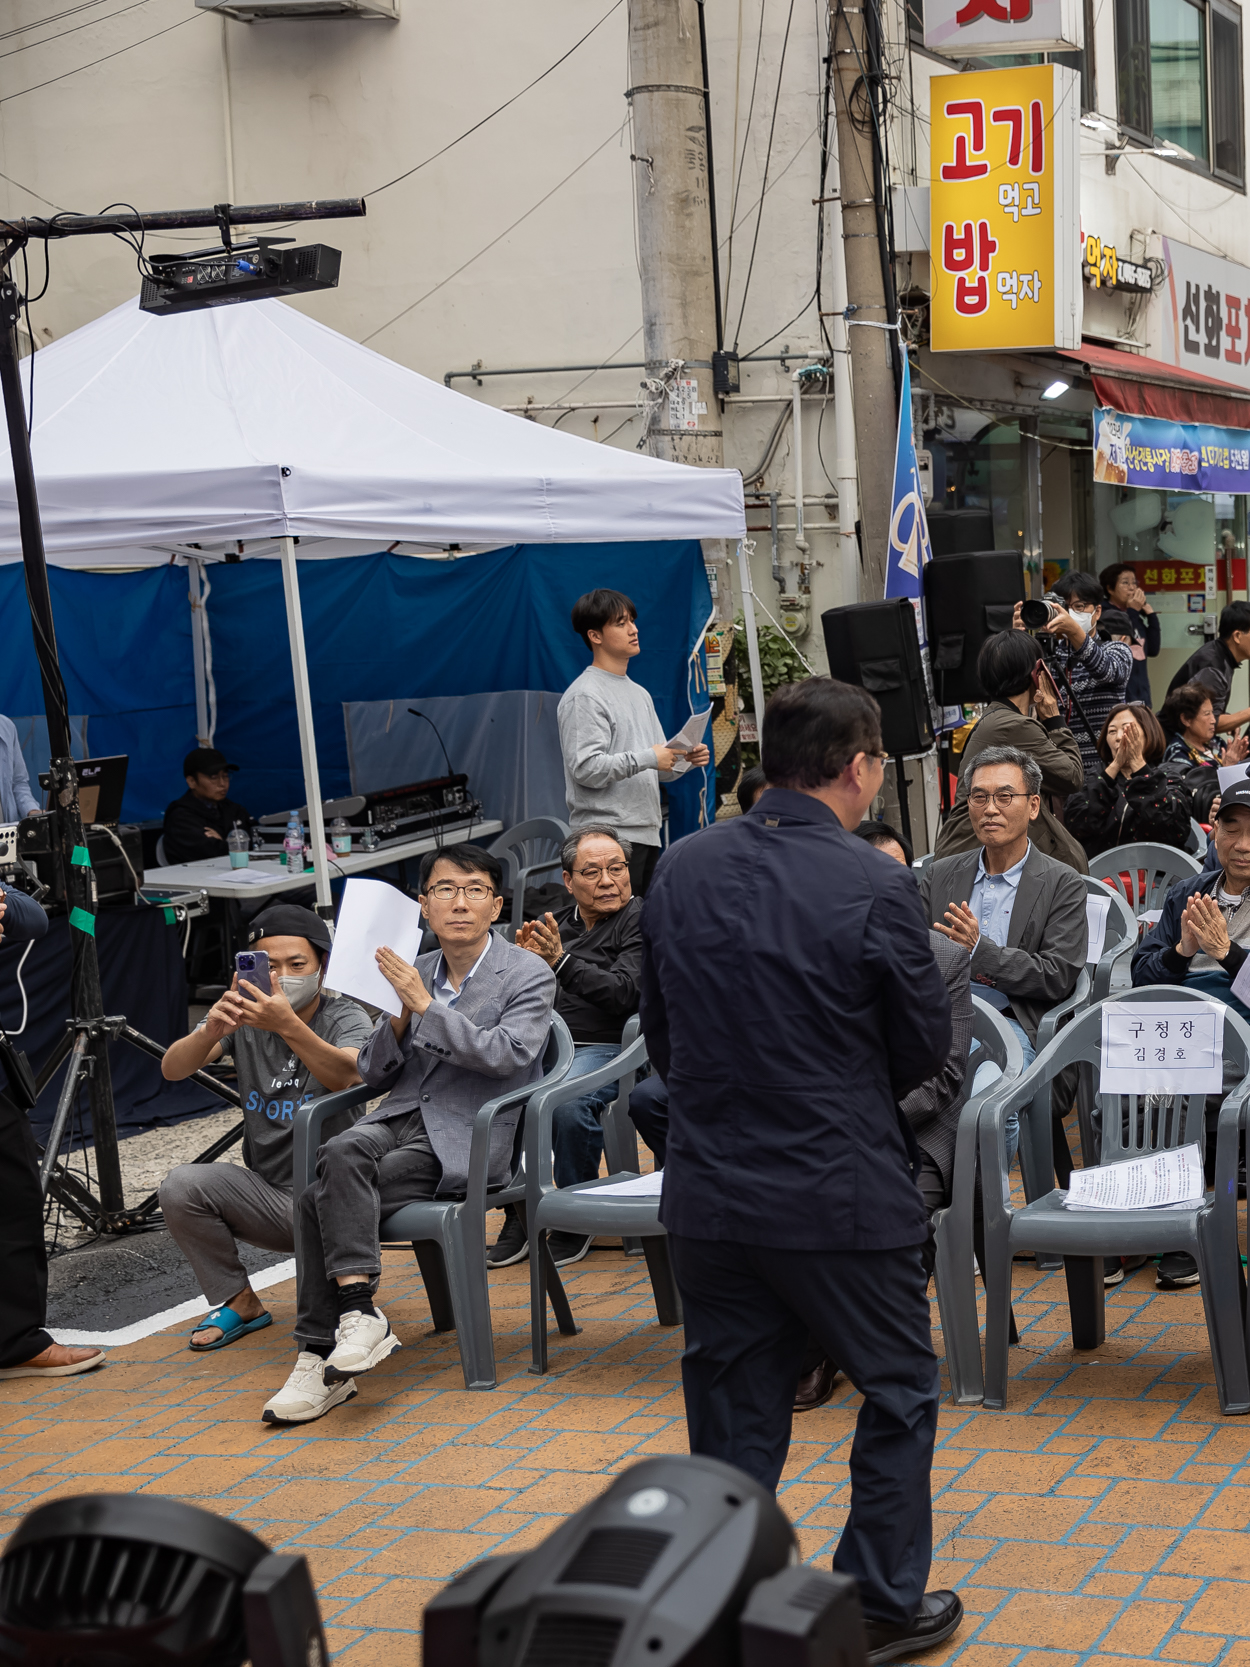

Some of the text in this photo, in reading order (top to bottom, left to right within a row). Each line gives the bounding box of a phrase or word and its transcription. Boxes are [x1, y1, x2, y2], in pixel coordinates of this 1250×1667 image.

[940, 98, 1045, 182] 고기
[998, 182, 1042, 223] 먹고
[942, 219, 999, 317] 밥
[1086, 235, 1118, 289] 먹자
[996, 270, 1042, 309] 먹자
